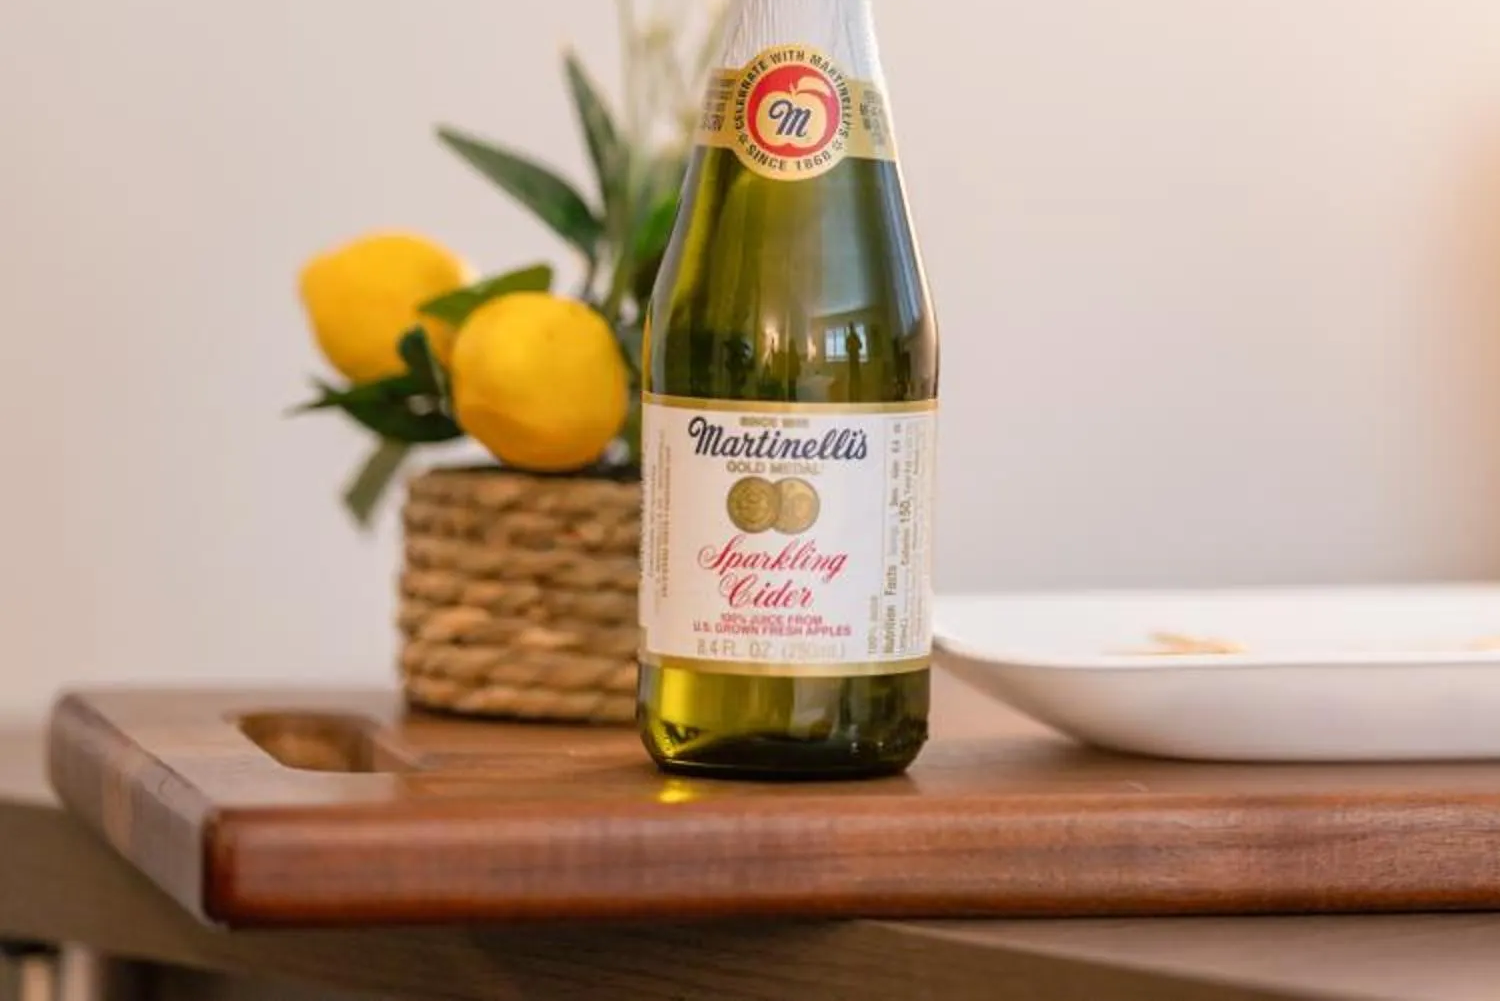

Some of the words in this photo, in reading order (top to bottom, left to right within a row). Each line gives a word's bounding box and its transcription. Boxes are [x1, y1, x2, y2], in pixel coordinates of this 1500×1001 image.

[735, 59, 768, 130] CELEBRATE
[770, 50, 805, 65] WITH
[810, 53, 852, 139] MARTINELLI'S
[746, 144, 787, 171] SINCE
[687, 416, 868, 460] Martinelli's
[726, 461, 766, 474] GOLD
[697, 534, 848, 584] Sparkling
[719, 573, 814, 608] Cider
[714, 623, 759, 635] GROWN
[761, 626, 804, 636] FRESH
[806, 625, 851, 637] APPLES
[787, 614, 823, 626] FROM
